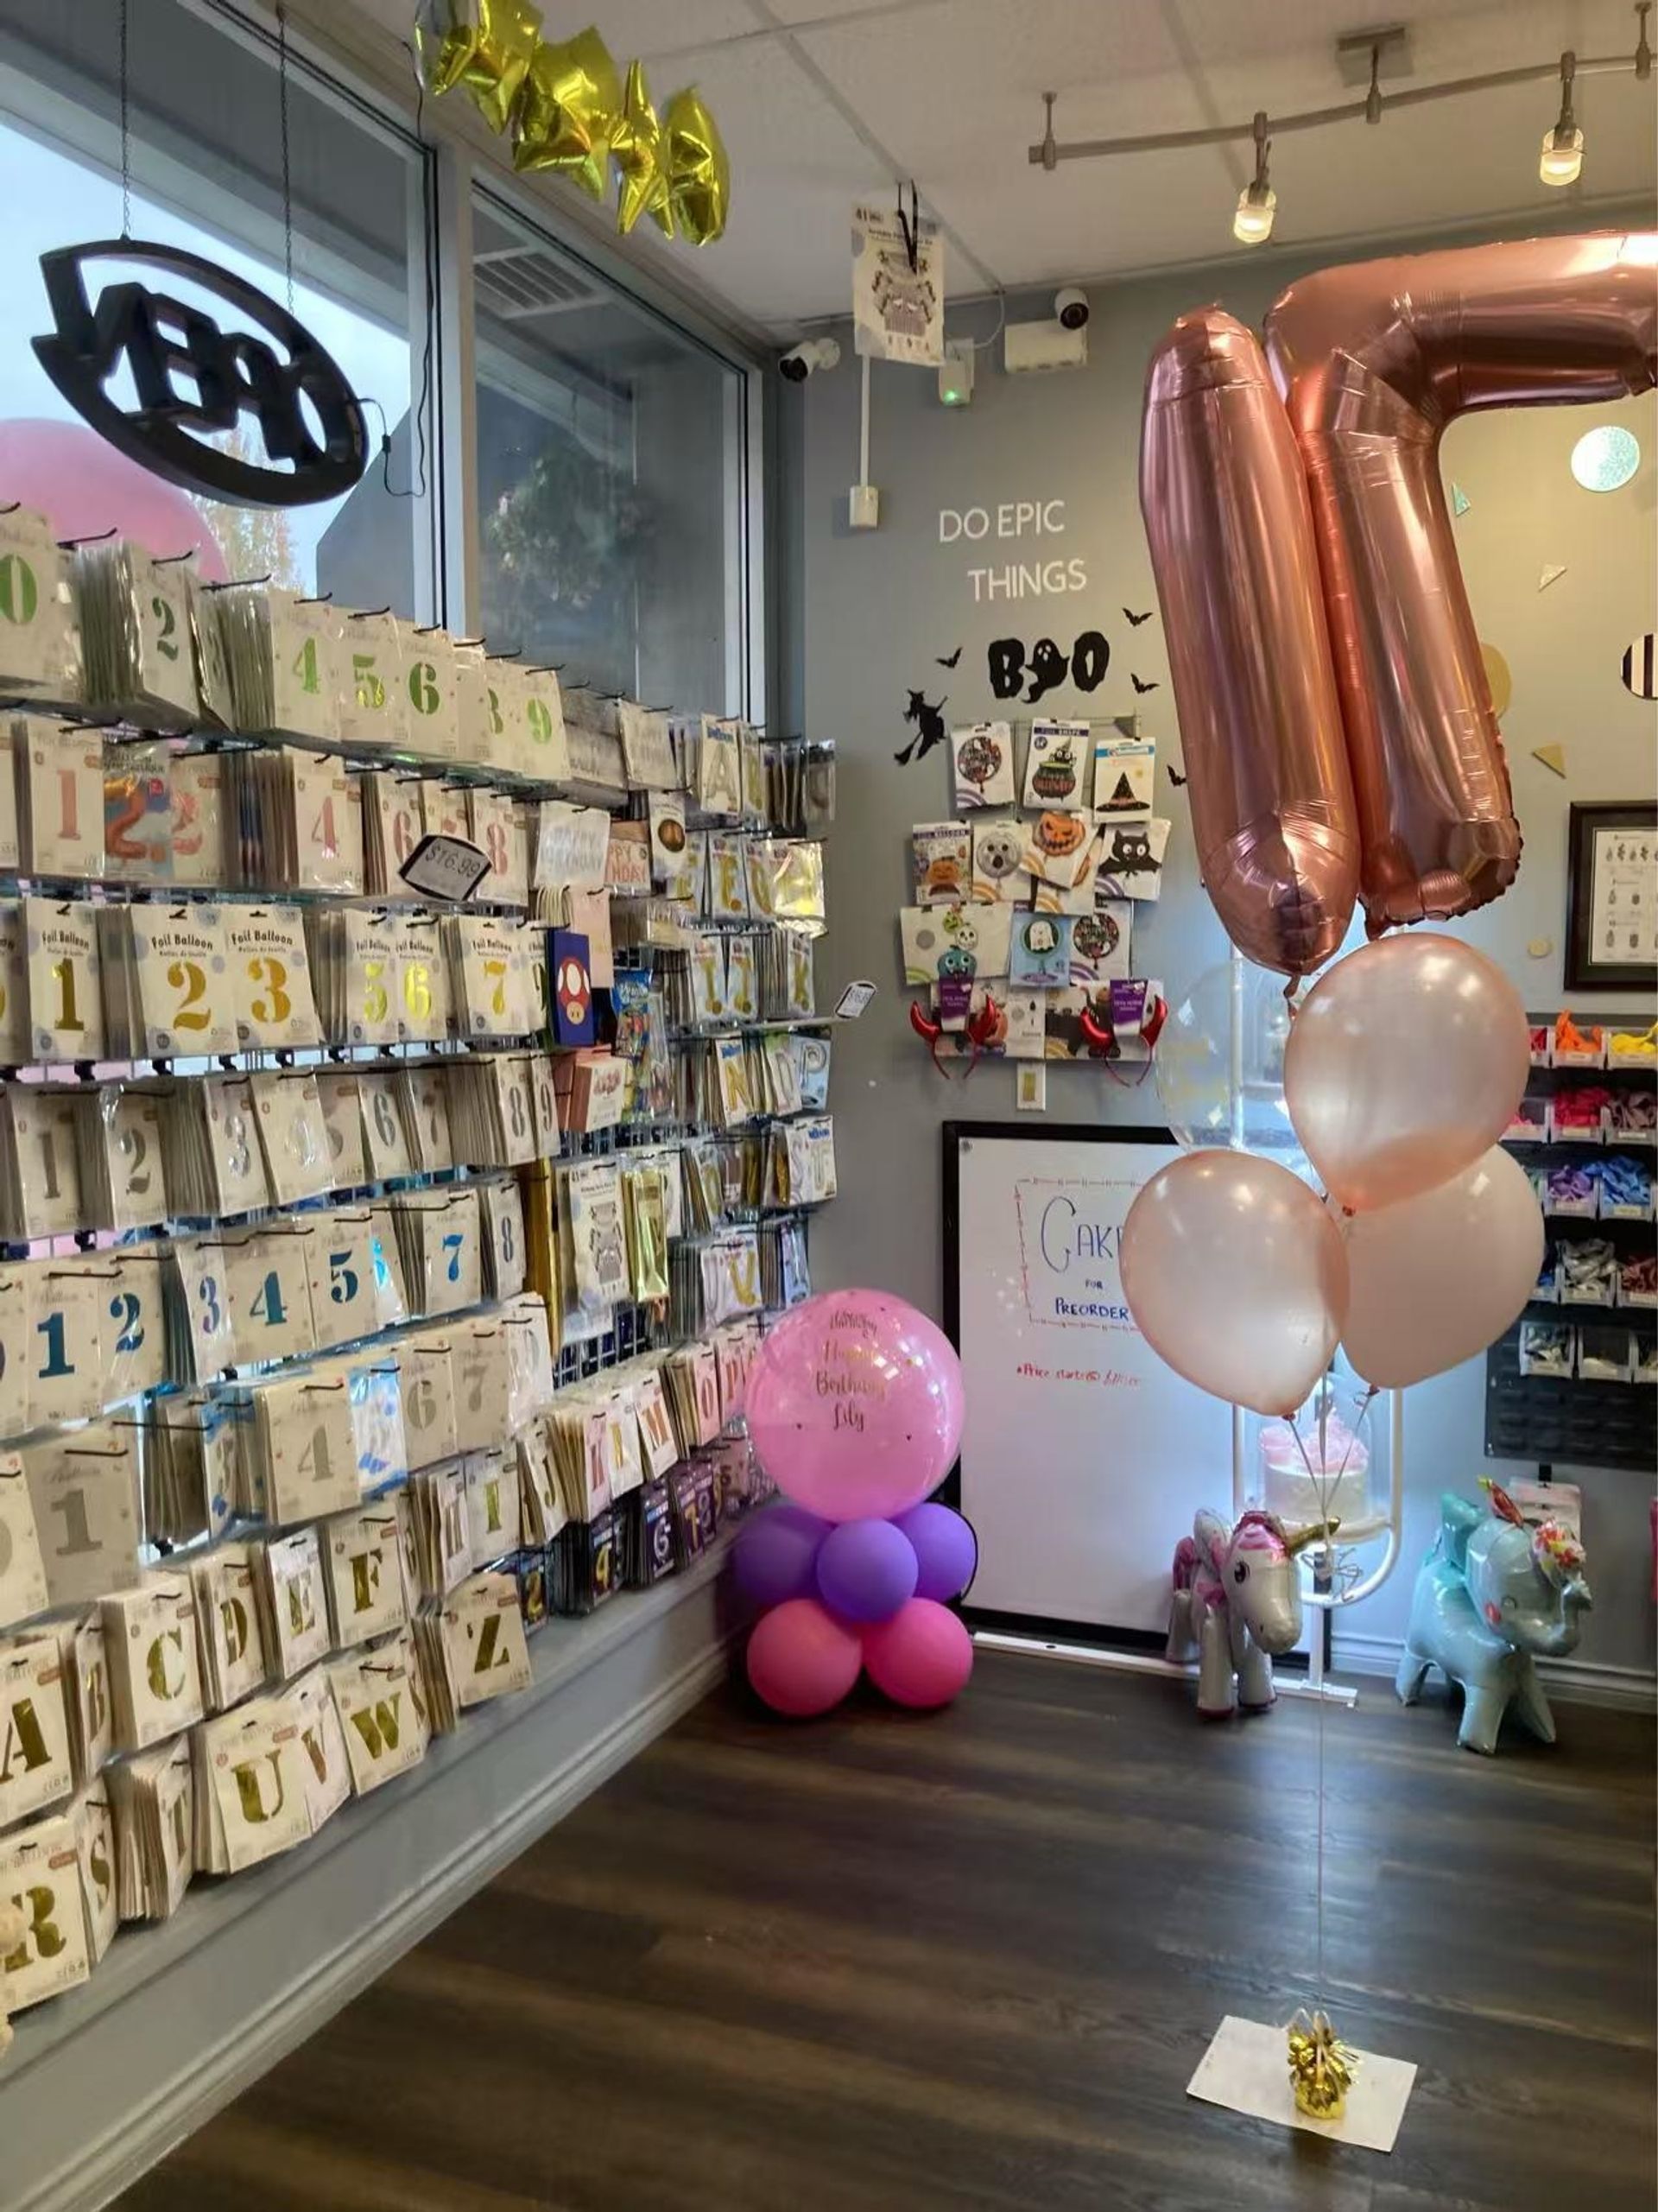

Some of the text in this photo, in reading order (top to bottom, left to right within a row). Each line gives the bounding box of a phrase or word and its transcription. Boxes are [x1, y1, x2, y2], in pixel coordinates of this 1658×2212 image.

[939, 499, 1066, 543] DO EPIC
[967, 559, 1088, 603] THINGS
[152, 596, 179, 662] 2
[292, 637, 320, 694] 4
[352, 653, 385, 709] 5
[408, 661, 440, 716] 6
[527, 698, 553, 745] 9
[57, 769, 82, 840] 1
[312, 796, 339, 859] 4
[486, 822, 508, 876] 8
[151, 933, 213, 951] Foil Balloon
[231, 929, 293, 946] Foil Balloon
[53, 957, 85, 1031] 1
[168, 960, 212, 1032] 2
[248, 956, 292, 1024] 3
[364, 961, 388, 1024] 5
[403, 959, 432, 1019] 6
[484, 959, 507, 1016] 7
[373, 1093, 396, 1147] 6
[509, 1086, 526, 1138] 8
[38, 1125, 61, 1200] 1
[120, 1128, 151, 1195] 2
[442, 1233, 465, 1282] 7
[501, 1216, 515, 1264] 8
[199, 1276, 221, 1334] 3
[249, 1271, 288, 1327] 4
[329, 1250, 358, 1304] 5
[1085, 1278, 1104, 1290] FOR
[110, 1293, 145, 1354] 2
[1054, 1296, 1130, 1321] PREORDER
[37, 1312, 75, 1379] 1
[464, 1364, 490, 1413] 7
[297, 1424, 334, 1482] 4
[49, 1487, 104, 1556] 1
[484, 1479, 503, 1534] I
[349, 1549, 384, 1614] F
[219, 1596, 248, 1668] D
[466, 1613, 510, 1674] Z
[145, 1626, 187, 1702] C
[0, 1696, 53, 1786] A
[350, 1690, 402, 1760] W
[231, 1748, 283, 1824] U
